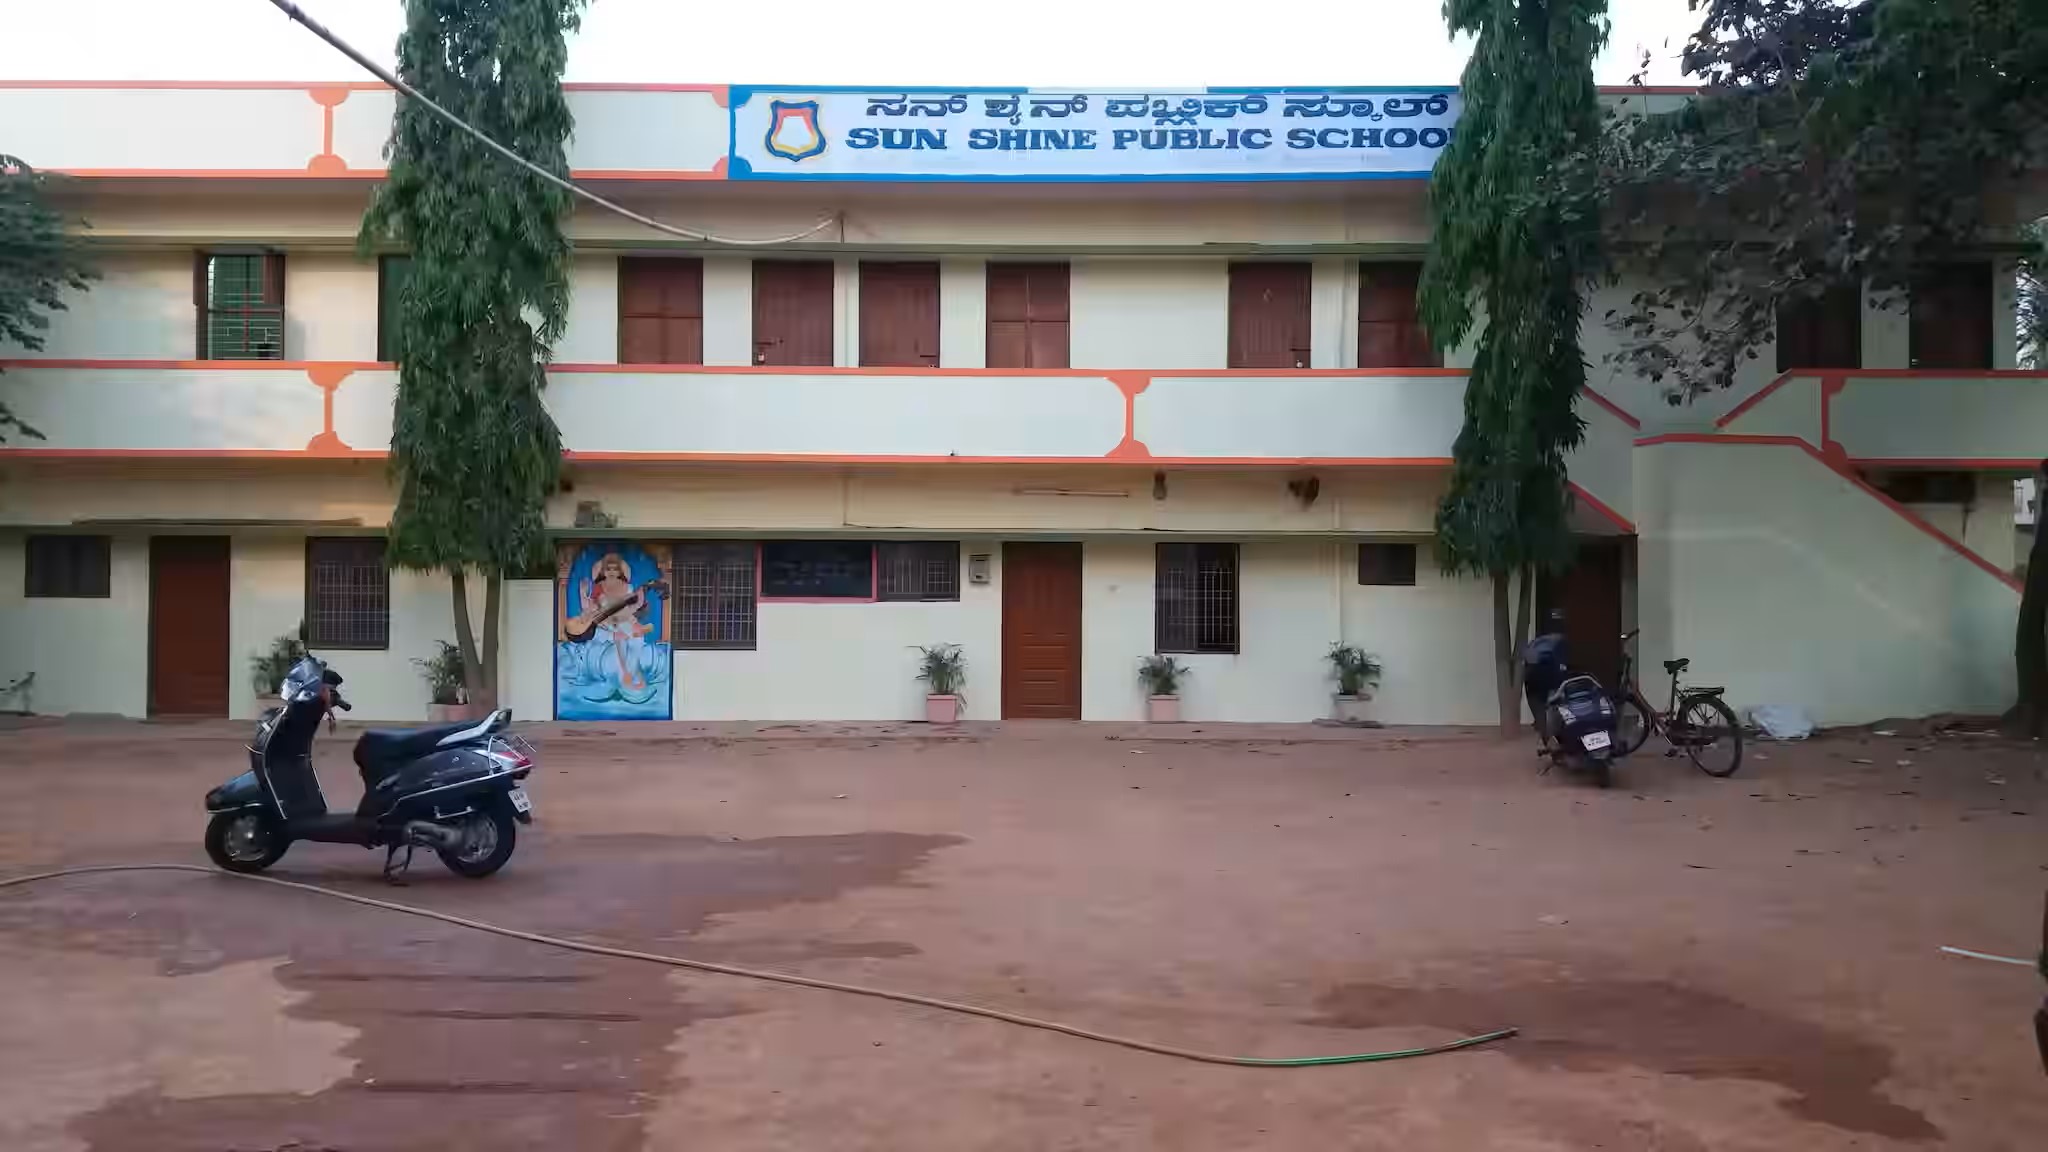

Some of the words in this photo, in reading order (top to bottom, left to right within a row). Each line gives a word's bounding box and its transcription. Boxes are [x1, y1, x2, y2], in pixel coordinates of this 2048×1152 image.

[866, 93, 967, 117] ಸನ್
[984, 94, 1088, 125] ಶೈನ್
[1105, 94, 1268, 126] ಪಬ್ಲಿಕ್
[845, 127, 948, 150] SUN
[968, 128, 1097, 150] SHINE
[1112, 128, 1273, 150] PUBLIC
